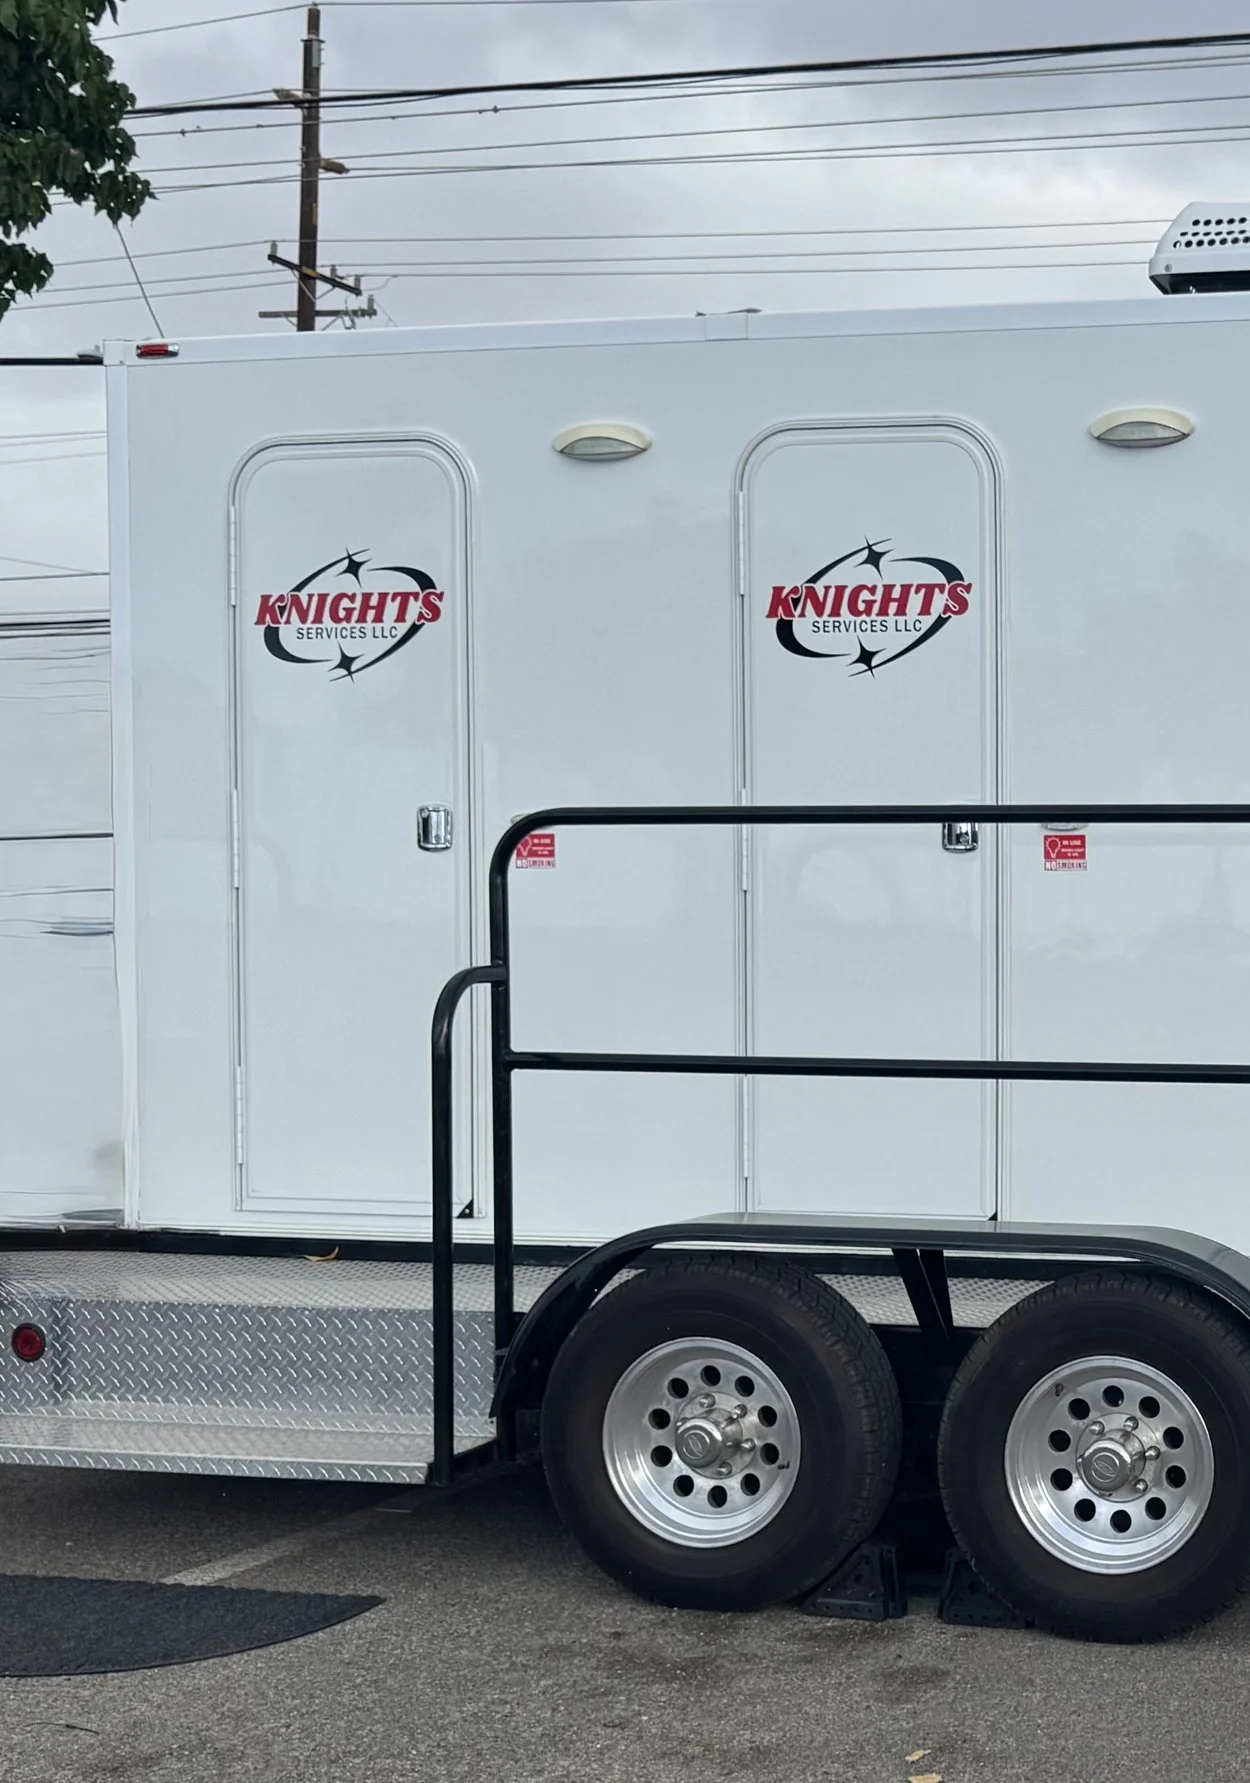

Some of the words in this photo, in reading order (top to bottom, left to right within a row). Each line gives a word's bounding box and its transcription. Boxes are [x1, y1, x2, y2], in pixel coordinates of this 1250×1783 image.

[765, 581, 973, 619] KNIGHTS
[254, 590, 446, 626] KNIGHTS
[296, 625, 368, 640] SERVICES
[372, 625, 398, 639] LLC
[811, 619, 889, 633] SERVICES
[895, 618, 923, 633] LLC
[516, 859, 527, 868] NO
[1045, 861, 1057, 870] NO
[1057, 861, 1087, 870] SMOKING
